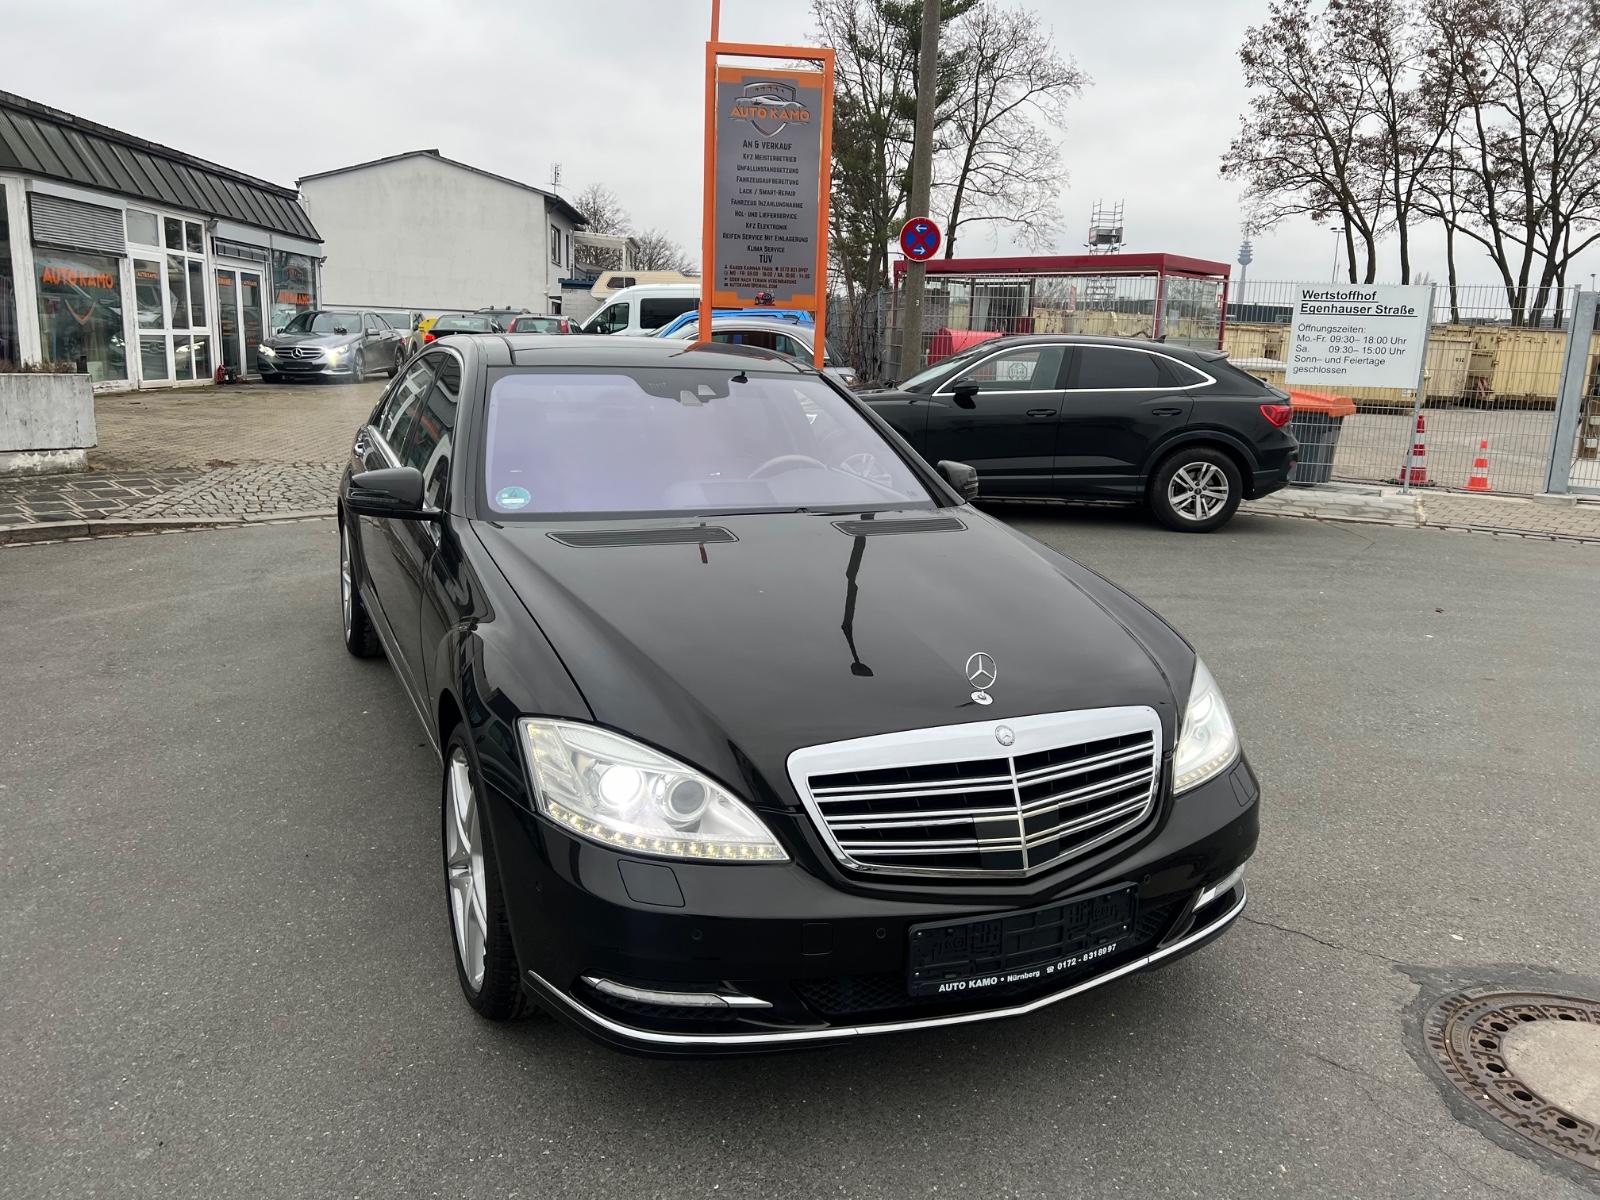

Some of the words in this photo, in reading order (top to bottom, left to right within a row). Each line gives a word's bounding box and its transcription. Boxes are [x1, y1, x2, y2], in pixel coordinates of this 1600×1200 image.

[730, 105, 767, 119] AUTO
[770, 108, 811, 120] KAMO
[743, 139, 752, 148] AN
[761, 141, 792, 150] VERKAUF
[42, 266, 77, 285] AUTO
[79, 270, 114, 289] KAMO
[1302, 289, 1378, 301] Wertstoffhof
[1300, 302, 1372, 315] Egenhauser
[1375, 304, 1415, 316] Straße
[1297, 323, 1367, 334] Öffnungszeiten:
[1363, 336, 1388, 345] 18:00
[1390, 336, 1407, 346] Uhr
[1295, 344, 1309, 353] Sa.
[1362, 346, 1387, 355] 15:00
[1388, 346, 1406, 356] Uhr
[1324, 355, 1341, 364] und
[1343, 356, 1386, 367] Feiertage
[1292, 365, 1347, 375] geschlossen
[938, 982, 966, 993] AUTO
[968, 976, 998, 989] KAMO
[1006, 970, 1040, 982] Nürnberg
[1056, 957, 1077, 971] 0172
[1082, 943, 1117, 962] 8318997
